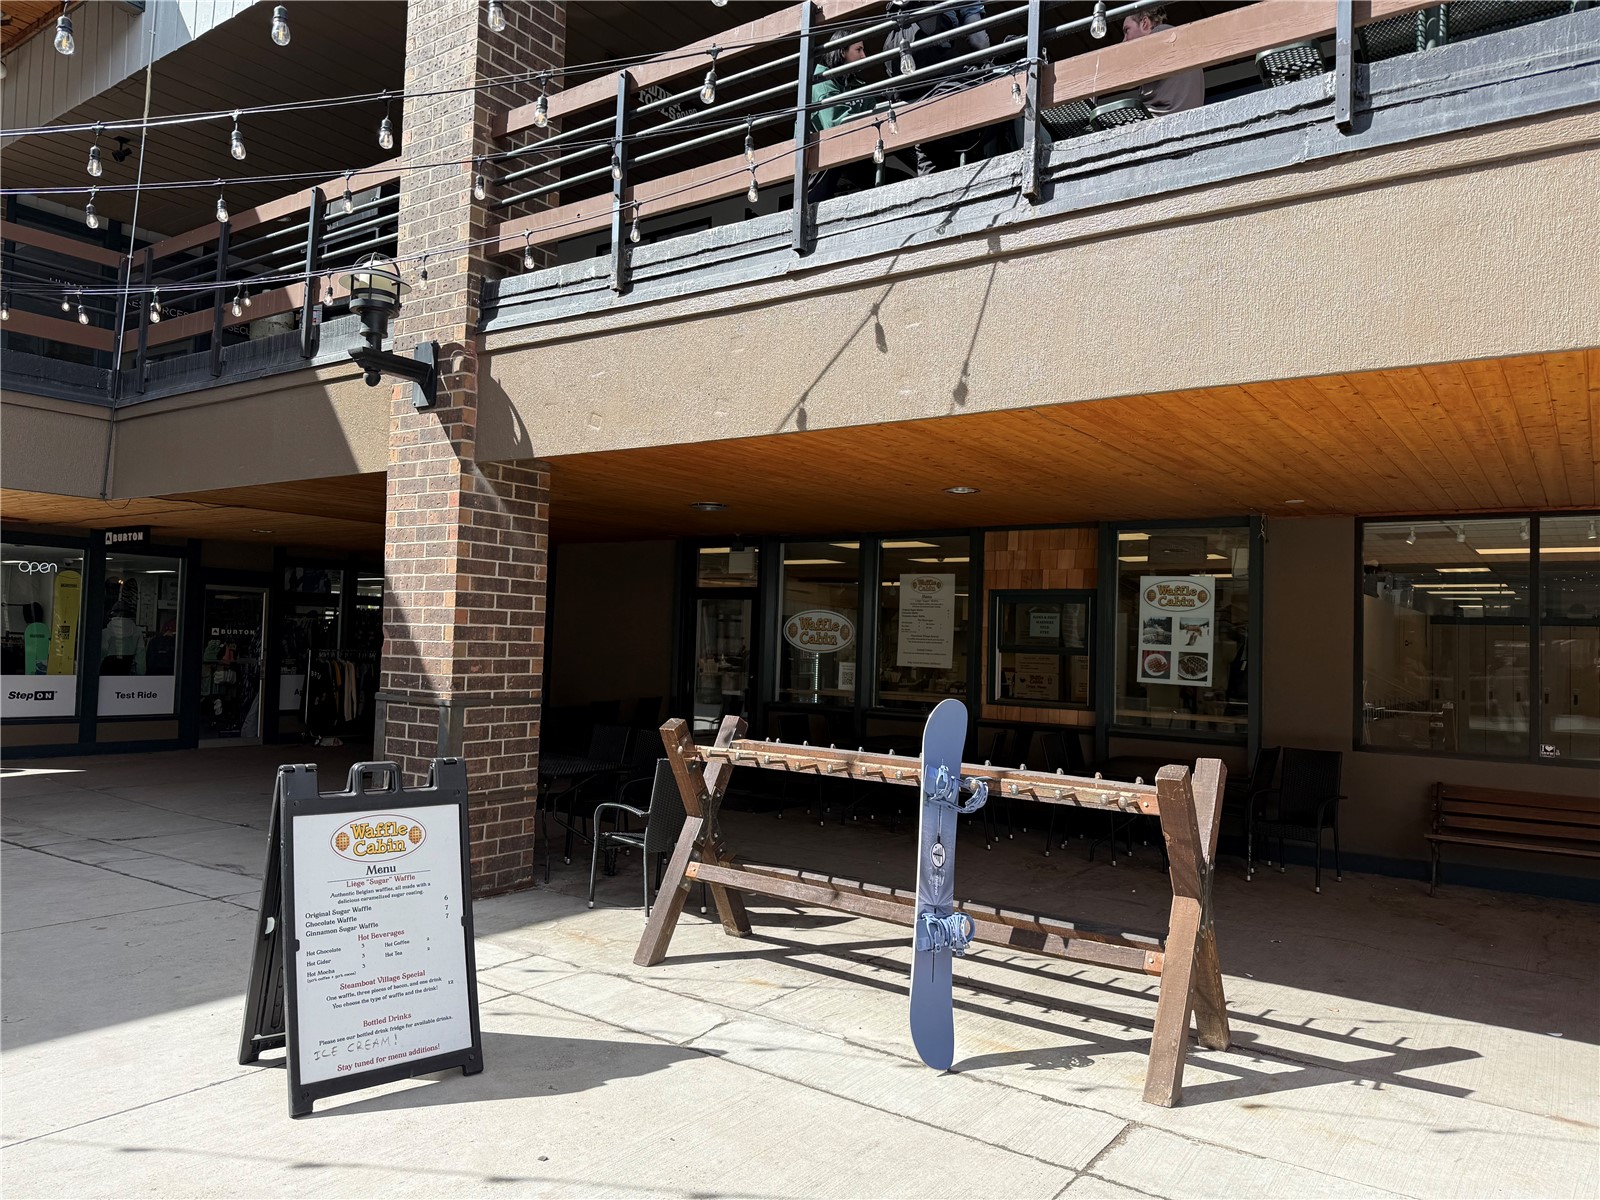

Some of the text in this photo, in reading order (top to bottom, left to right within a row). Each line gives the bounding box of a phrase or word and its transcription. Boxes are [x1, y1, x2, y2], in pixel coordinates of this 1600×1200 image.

[112, 532, 143, 542] BURTON
[18, 561, 57, 575] open
[1157, 584, 1197, 596] Waffle
[1158, 596, 1195, 607] Cabin
[799, 617, 840, 632] Waffle
[220, 628, 255, 636] BURTON
[799, 631, 838, 646] Cabin
[115, 691, 157, 699] Test Ride
[350, 821, 408, 840] Waffle
[352, 838, 406, 856] Cabin
[366, 865, 396, 875] Menu
[346, 880, 365, 888] Liège
[394, 874, 415, 882] Waffle
[330, 890, 355, 899] Authentic
[337, 897, 360, 905] delicious
[360, 894, 391, 902] caramelized
[305, 910, 331, 919] Original
[331, 908, 351, 916] Sugar
[351, 905, 372, 913] Waffle
[305, 919, 336, 928] Chocolate
[336, 916, 357, 924] Waffle
[305, 927, 338, 937] Cinnamon
[338, 925, 358, 934] Sugar
[358, 922, 378, 930] Waffle
[357, 929, 405, 941] Hot Beverages
[316, 947, 341, 955] Chocolate
[339, 970, 426, 990] Steamboat Village Special
[332, 1002, 343, 1010] You
[343, 1000, 361, 1008] choose
[362, 1012, 412, 1027] Bottled Drinks
[319, 1038, 336, 1046] Please
[356, 1030, 374, 1039] bottled
[374, 1027, 389, 1035] drink
[389, 1024, 405, 1032] fridge
[413, 1018, 436, 1027] available
[313, 1033, 398, 1060] ICE CREAM!
[337, 1043, 441, 1072] Stay tuned for menu additions!
